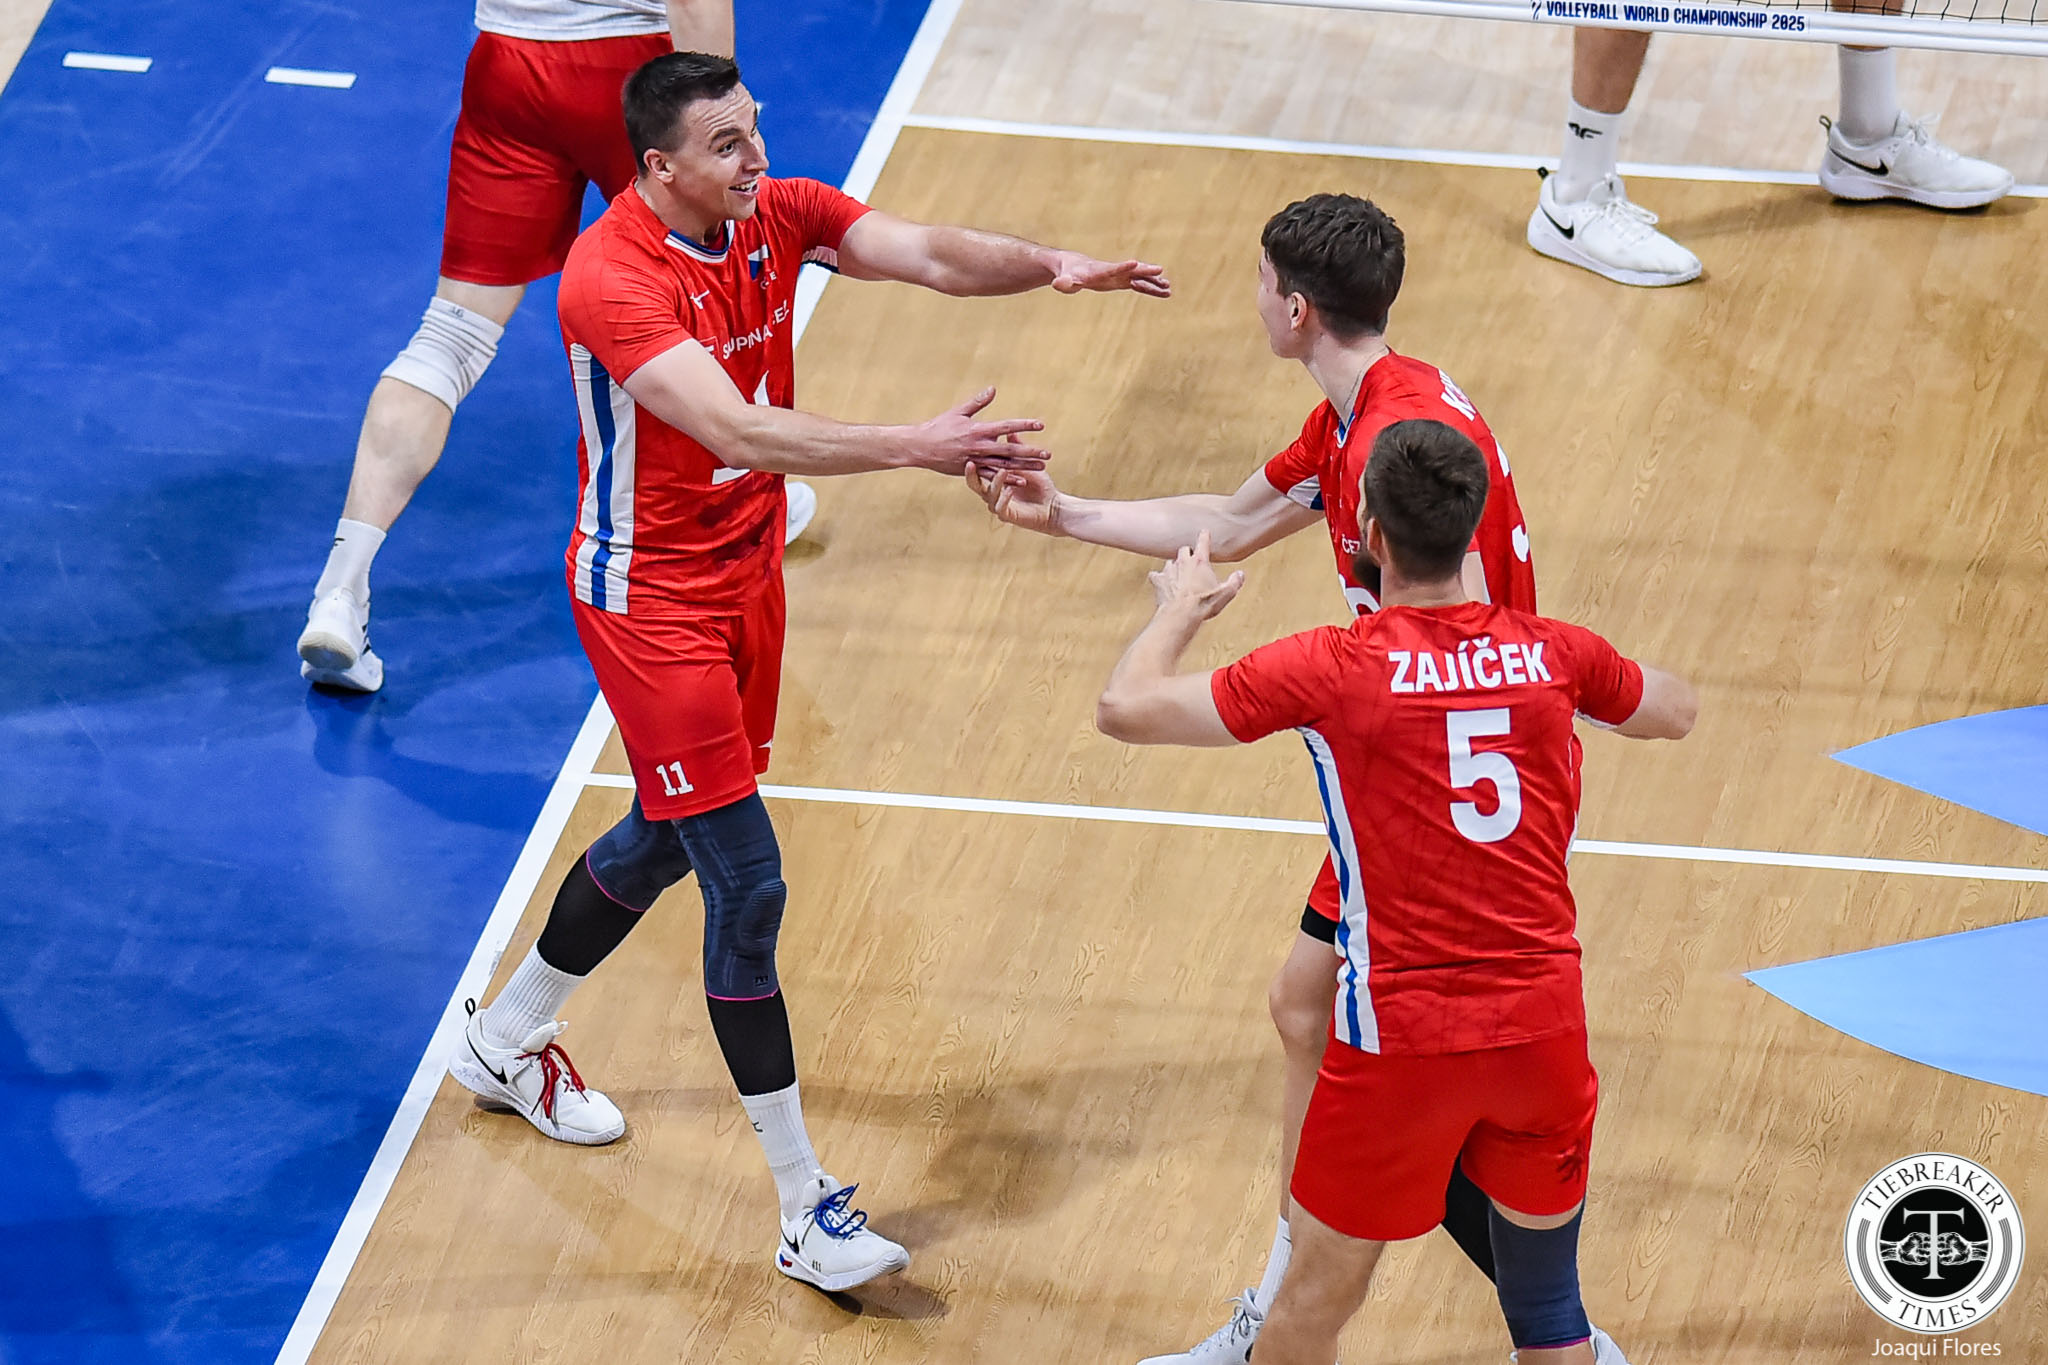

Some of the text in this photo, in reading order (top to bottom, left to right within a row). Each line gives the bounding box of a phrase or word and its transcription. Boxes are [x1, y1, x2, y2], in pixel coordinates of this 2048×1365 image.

[1546, 1, 1805, 31] VOLLEYBALL WORLD CHAMPIONSHIP 2025
[1388, 637, 1551, 692] ZAJÍČEK
[656, 761, 694, 796] 11
[1446, 708, 1521, 842] 5
